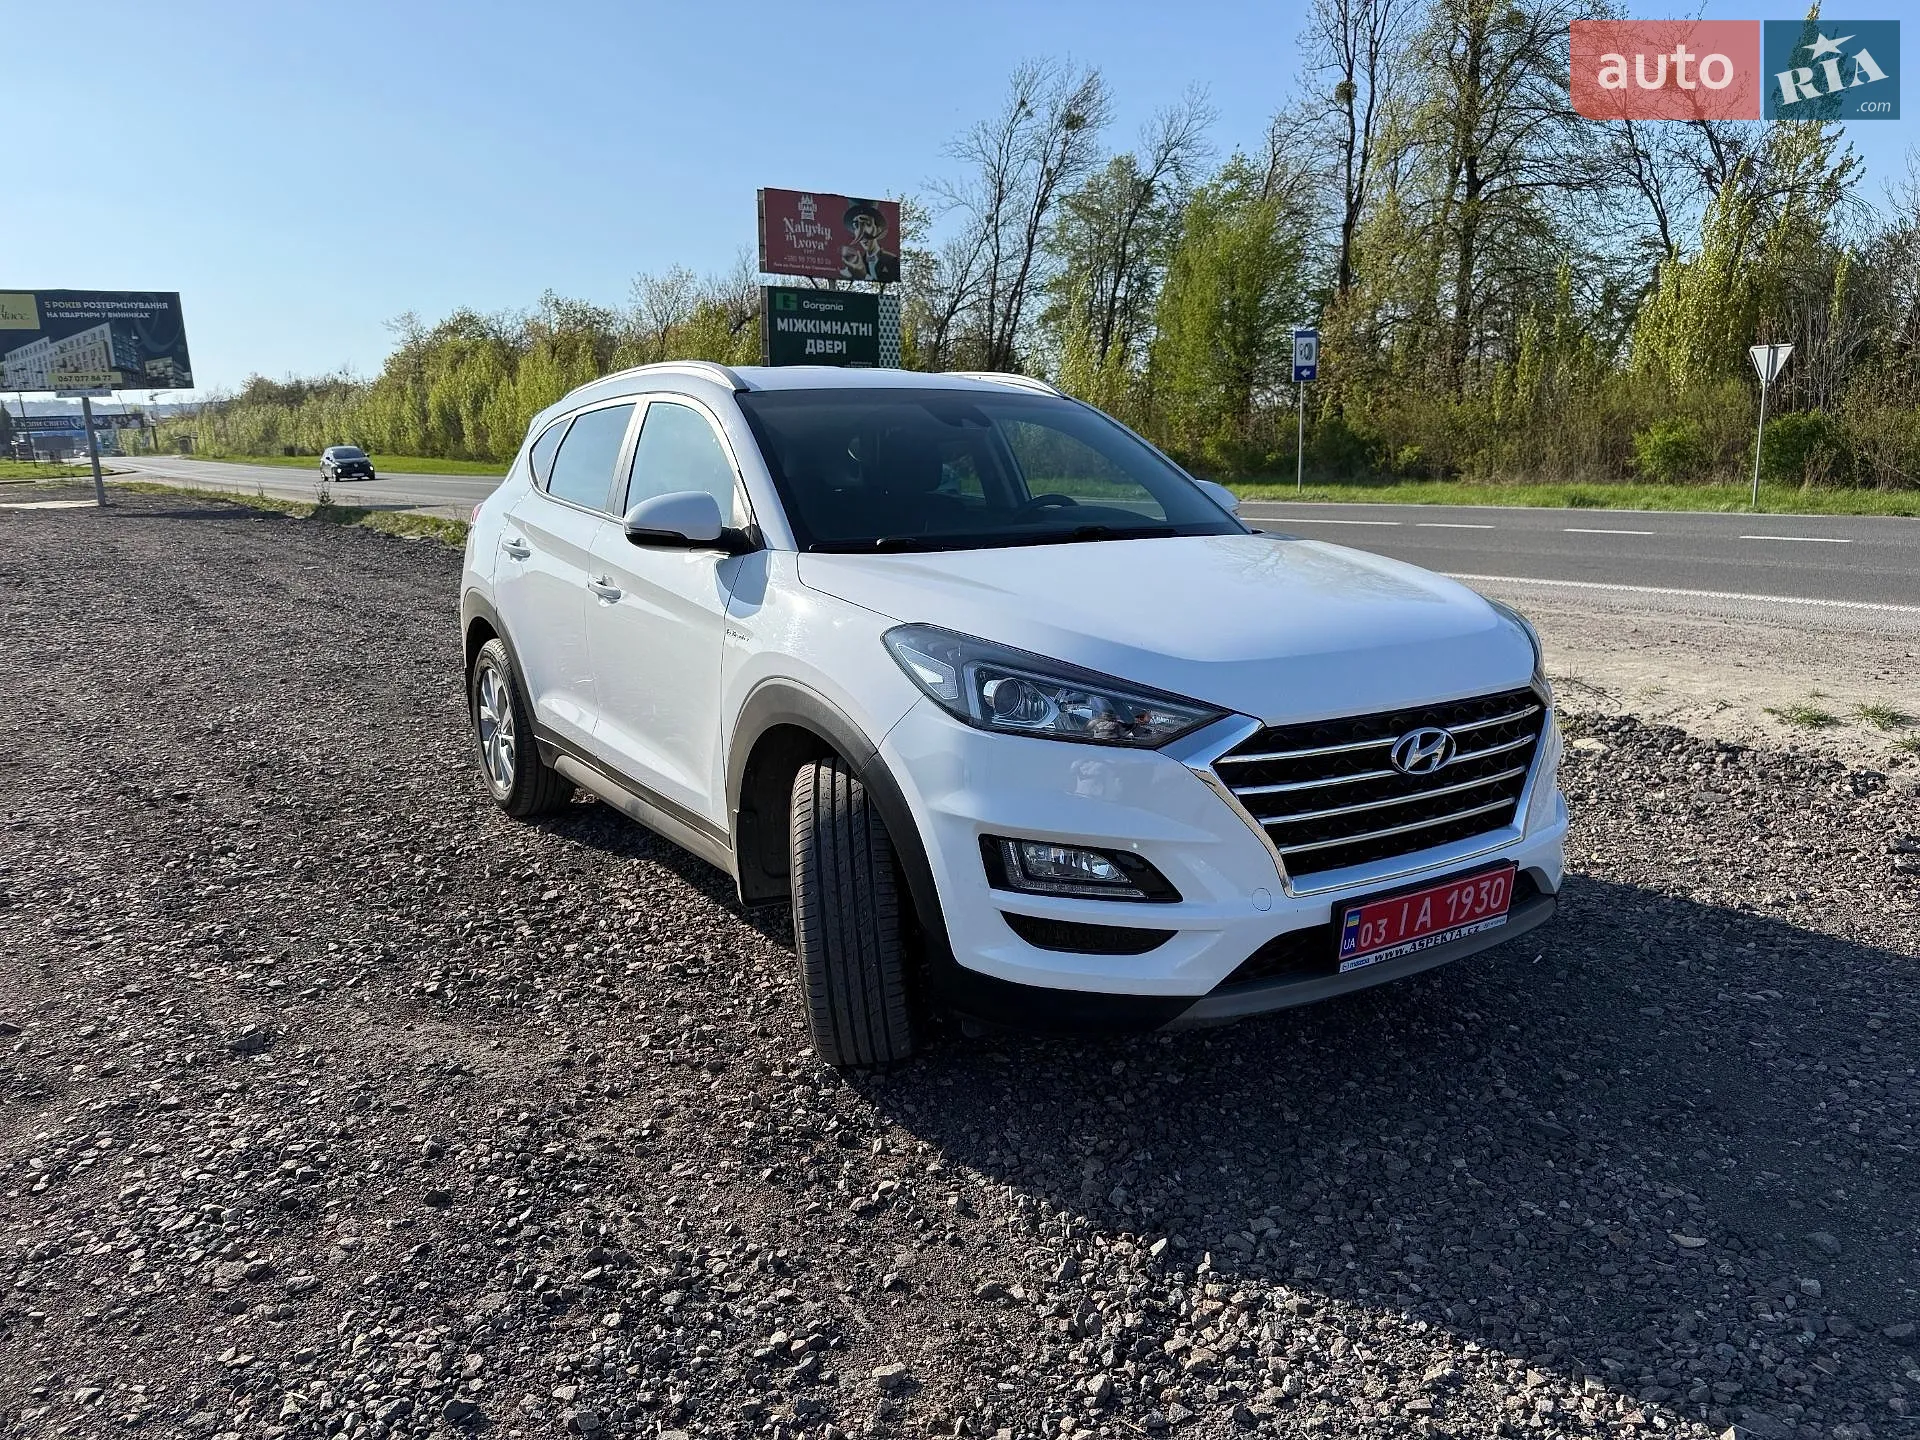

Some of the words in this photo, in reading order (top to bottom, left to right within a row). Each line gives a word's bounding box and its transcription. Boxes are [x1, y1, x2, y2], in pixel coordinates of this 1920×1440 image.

[793, 234, 825, 251] Lvova
[44, 301, 51, 309] 5
[52, 301, 81, 309] РОКІВ
[83, 301, 169, 310] РОЗТЕРМІНУВАННЯ
[803, 301, 844, 311] Gorgania
[777, 318, 873, 336] МІЖКІМНАТНІ
[805, 339, 847, 355] ДВЕРІ
[1360, 917, 1388, 948] 03
[1399, 896, 1431, 936] IA
[1447, 876, 1505, 922] 1930
[1343, 938, 1356, 950] UA
